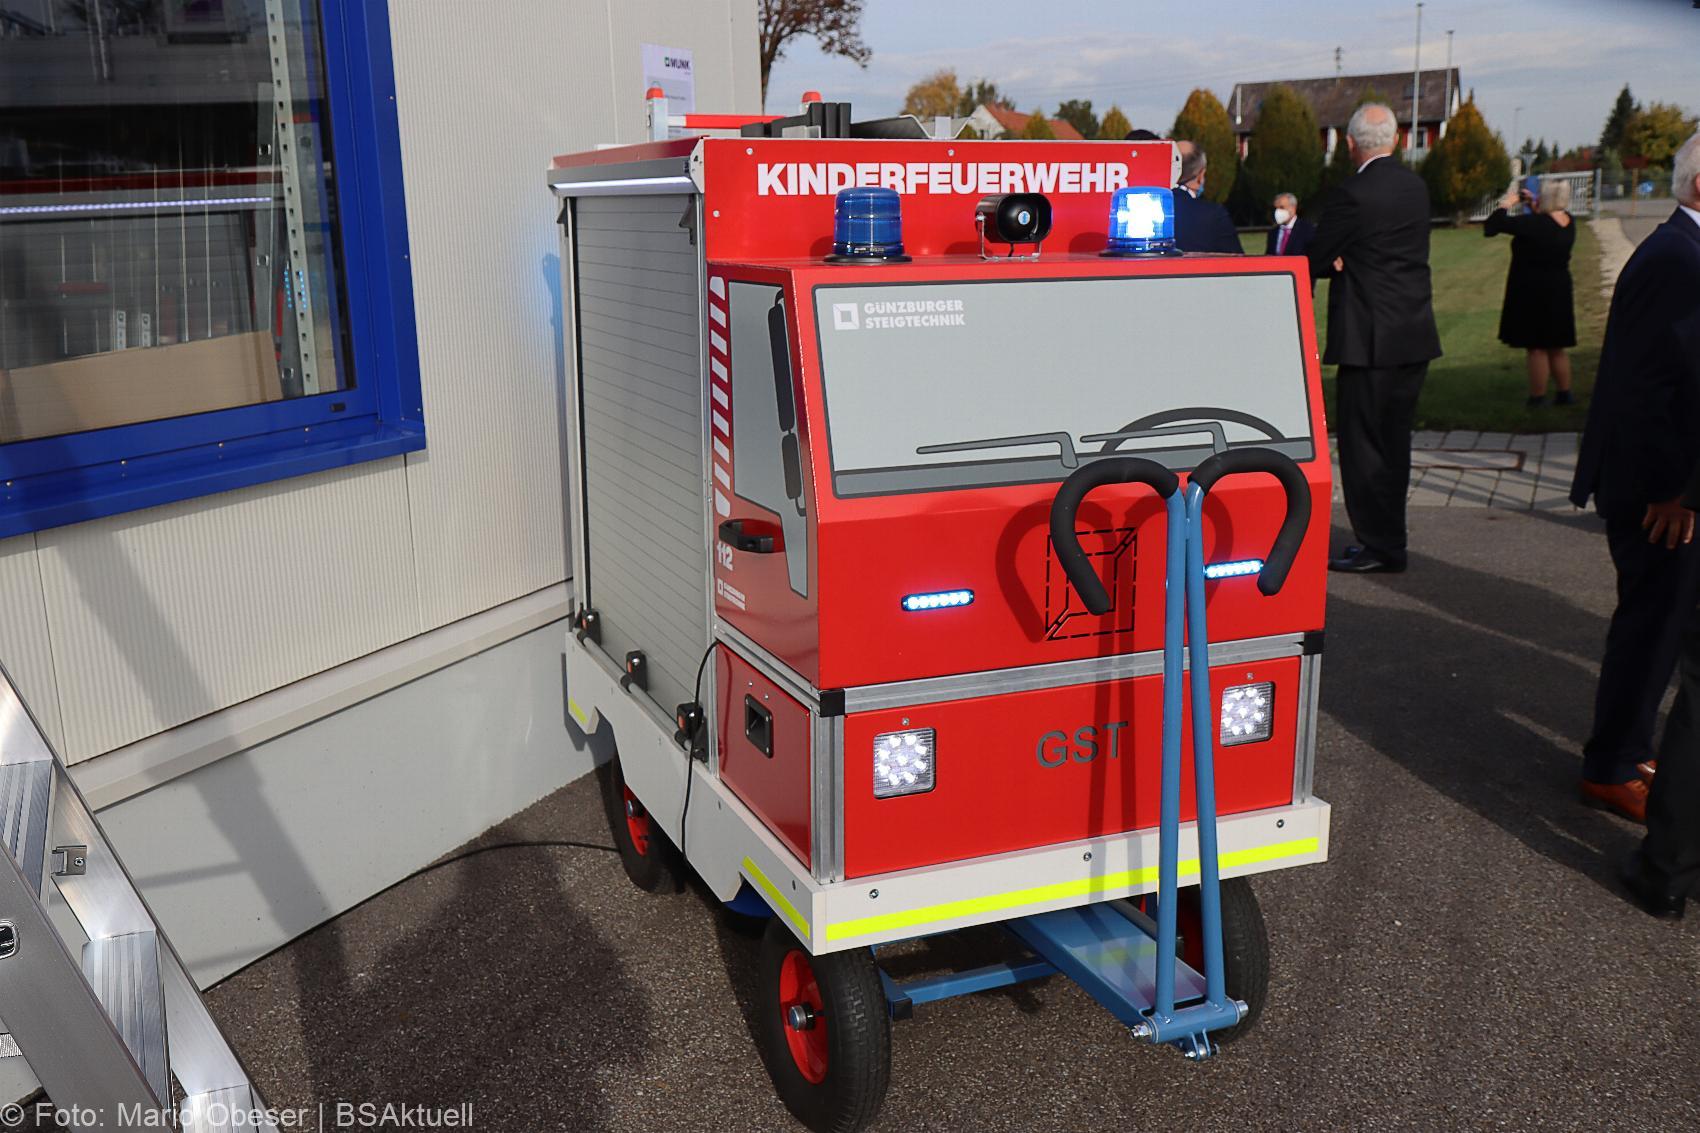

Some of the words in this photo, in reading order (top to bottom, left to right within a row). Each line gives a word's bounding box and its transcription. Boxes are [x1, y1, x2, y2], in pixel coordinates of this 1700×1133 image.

[757, 161, 1129, 196] KINDERFEUERWEHR
[865, 314, 966, 329] STEIGTECHNIK
[1036, 721, 1128, 768] GST
